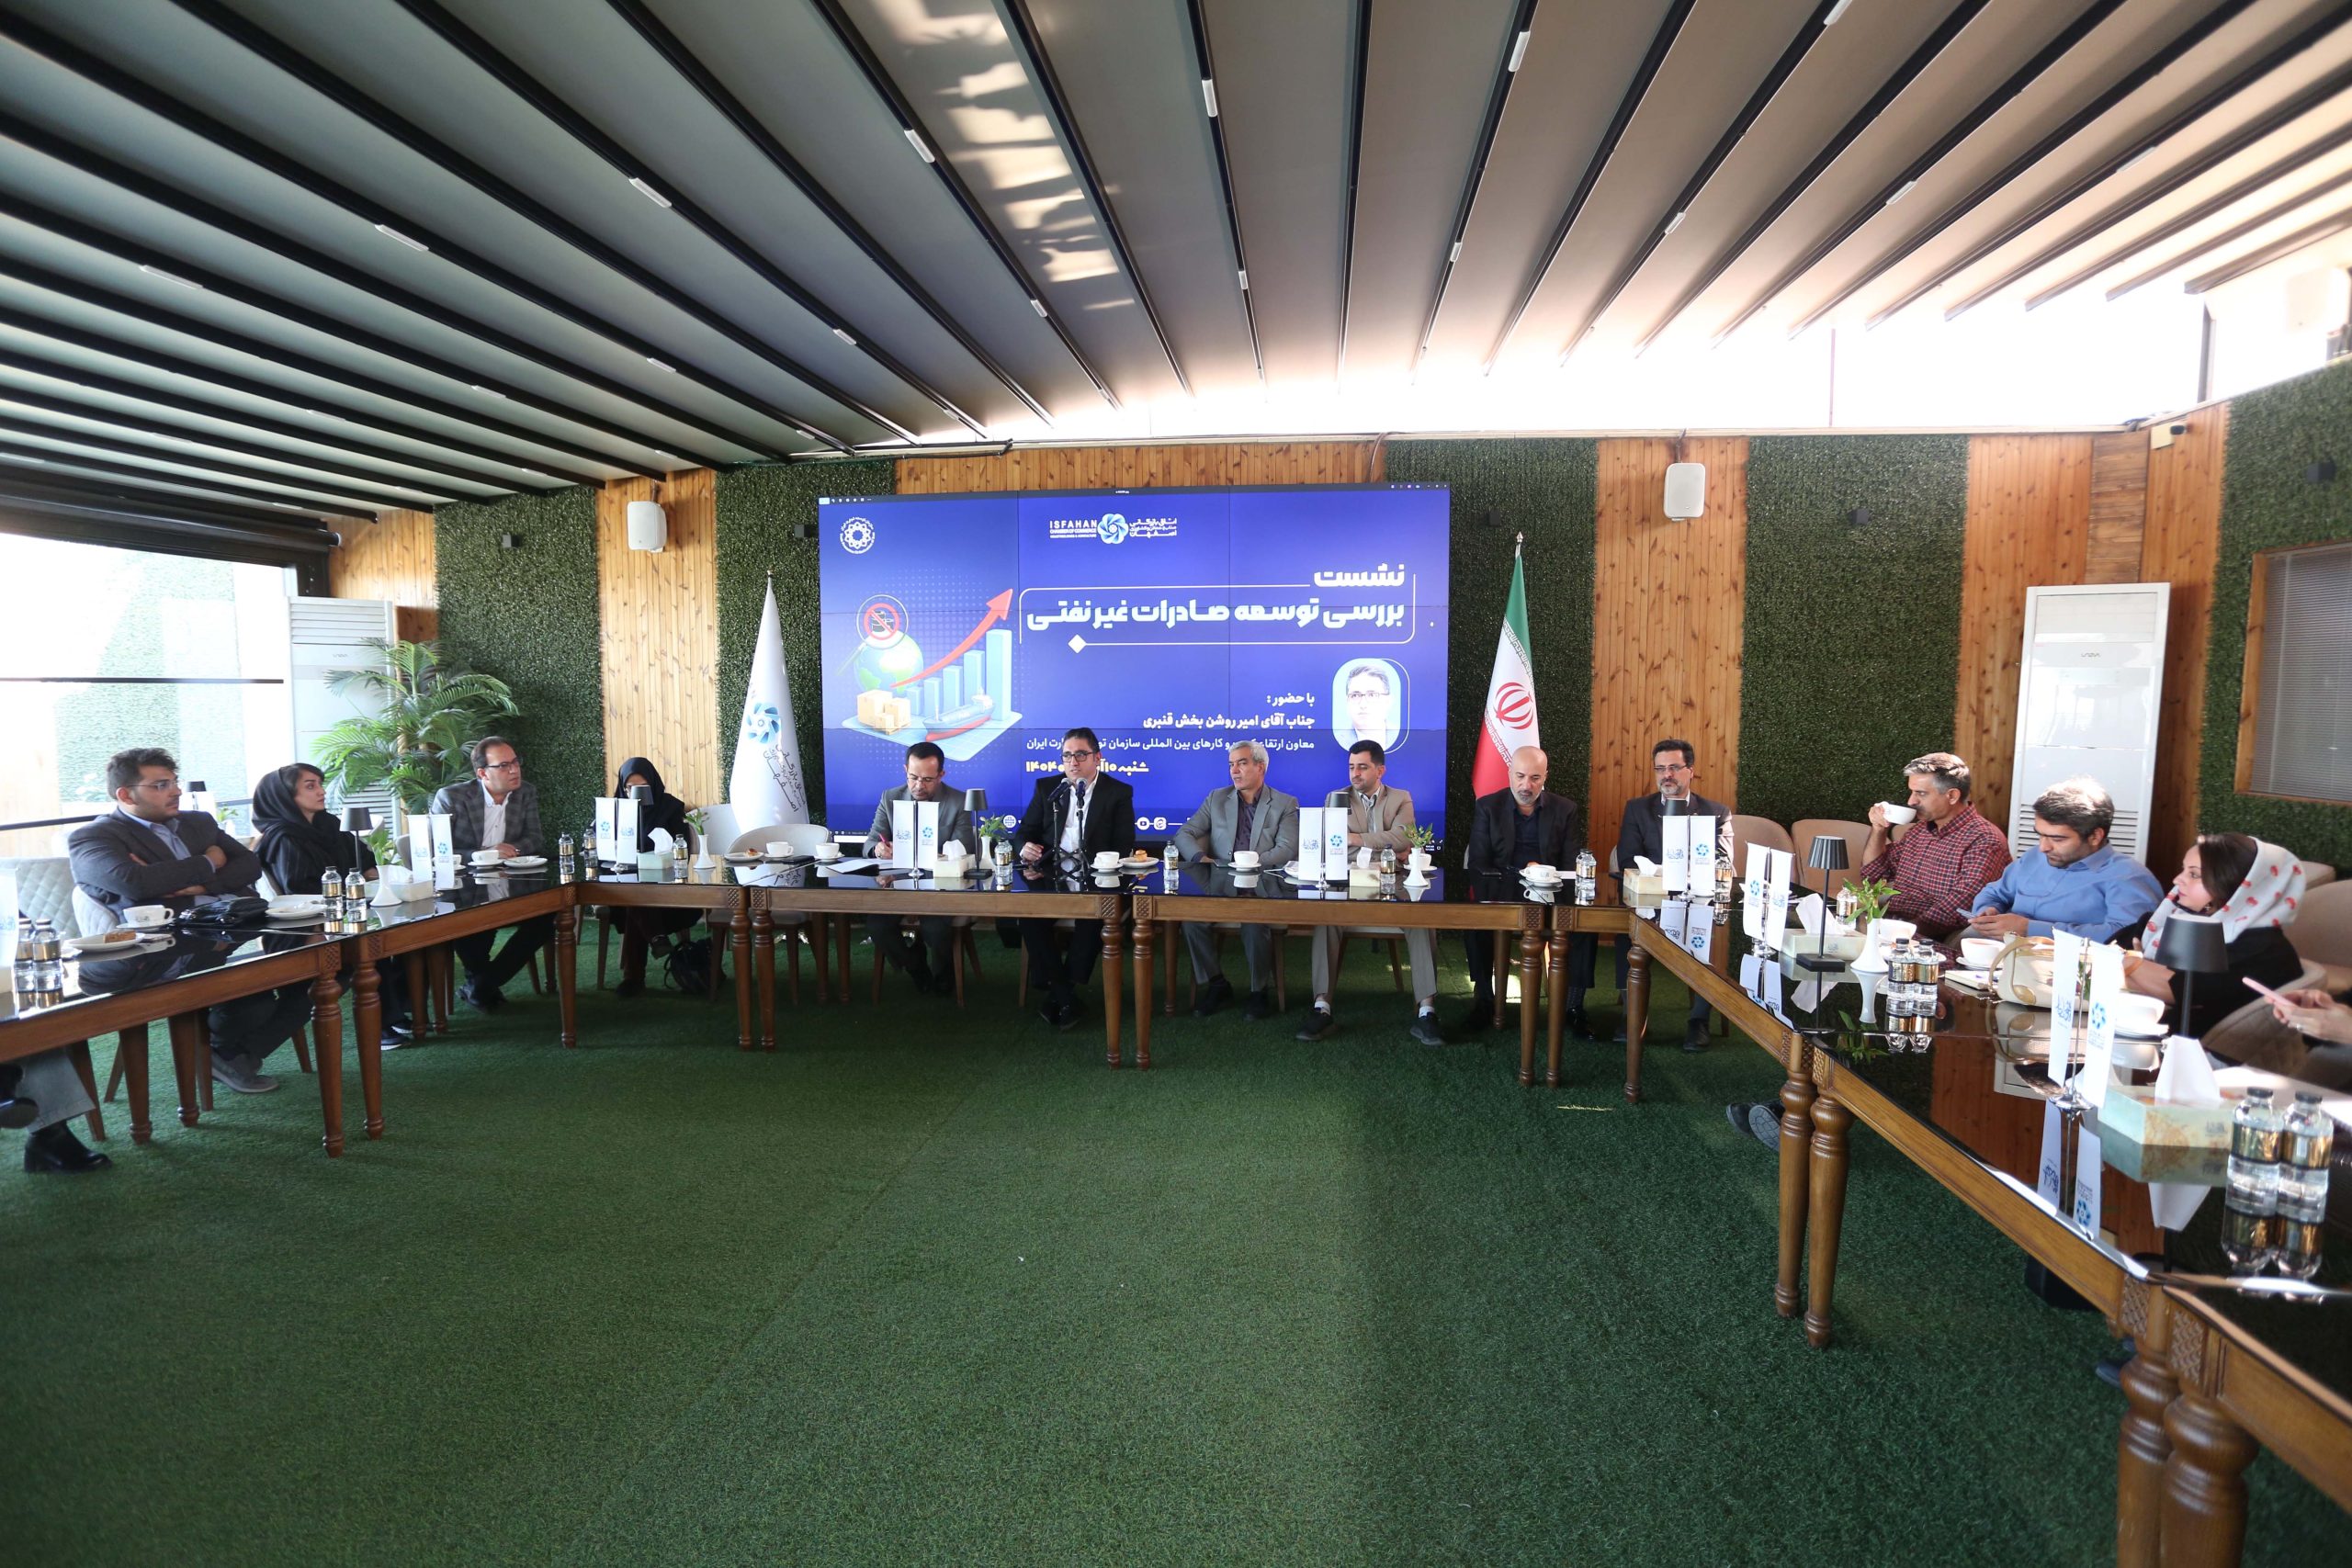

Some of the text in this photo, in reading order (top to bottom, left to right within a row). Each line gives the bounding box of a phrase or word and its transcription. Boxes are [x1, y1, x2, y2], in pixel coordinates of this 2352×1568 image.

[1050, 520, 1097, 529] ISFAHAN
[1314, 562, 1405, 588] نشست
[1026, 598, 1405, 631] بررسی توسعه صادرات غیر نفتی
[1306, 692, 1315, 707] با
[1143, 712, 1315, 729] جناب آقای امیر روشن بخش قنبری
[1026, 738, 1047, 750] ایران
[1108, 738, 1141, 750] سازمان
[1143, 738, 1172, 750] المللی
[1173, 739, 1191, 750] بین
[1192, 738, 1223, 750] کارهای
[1285, 739, 1315, 751] معاون
[1025, 761, 1057, 773] ۱۴۰۴
[1117, 761, 1149, 776] شنبه
[763, 750, 799, 812] اصفهان
